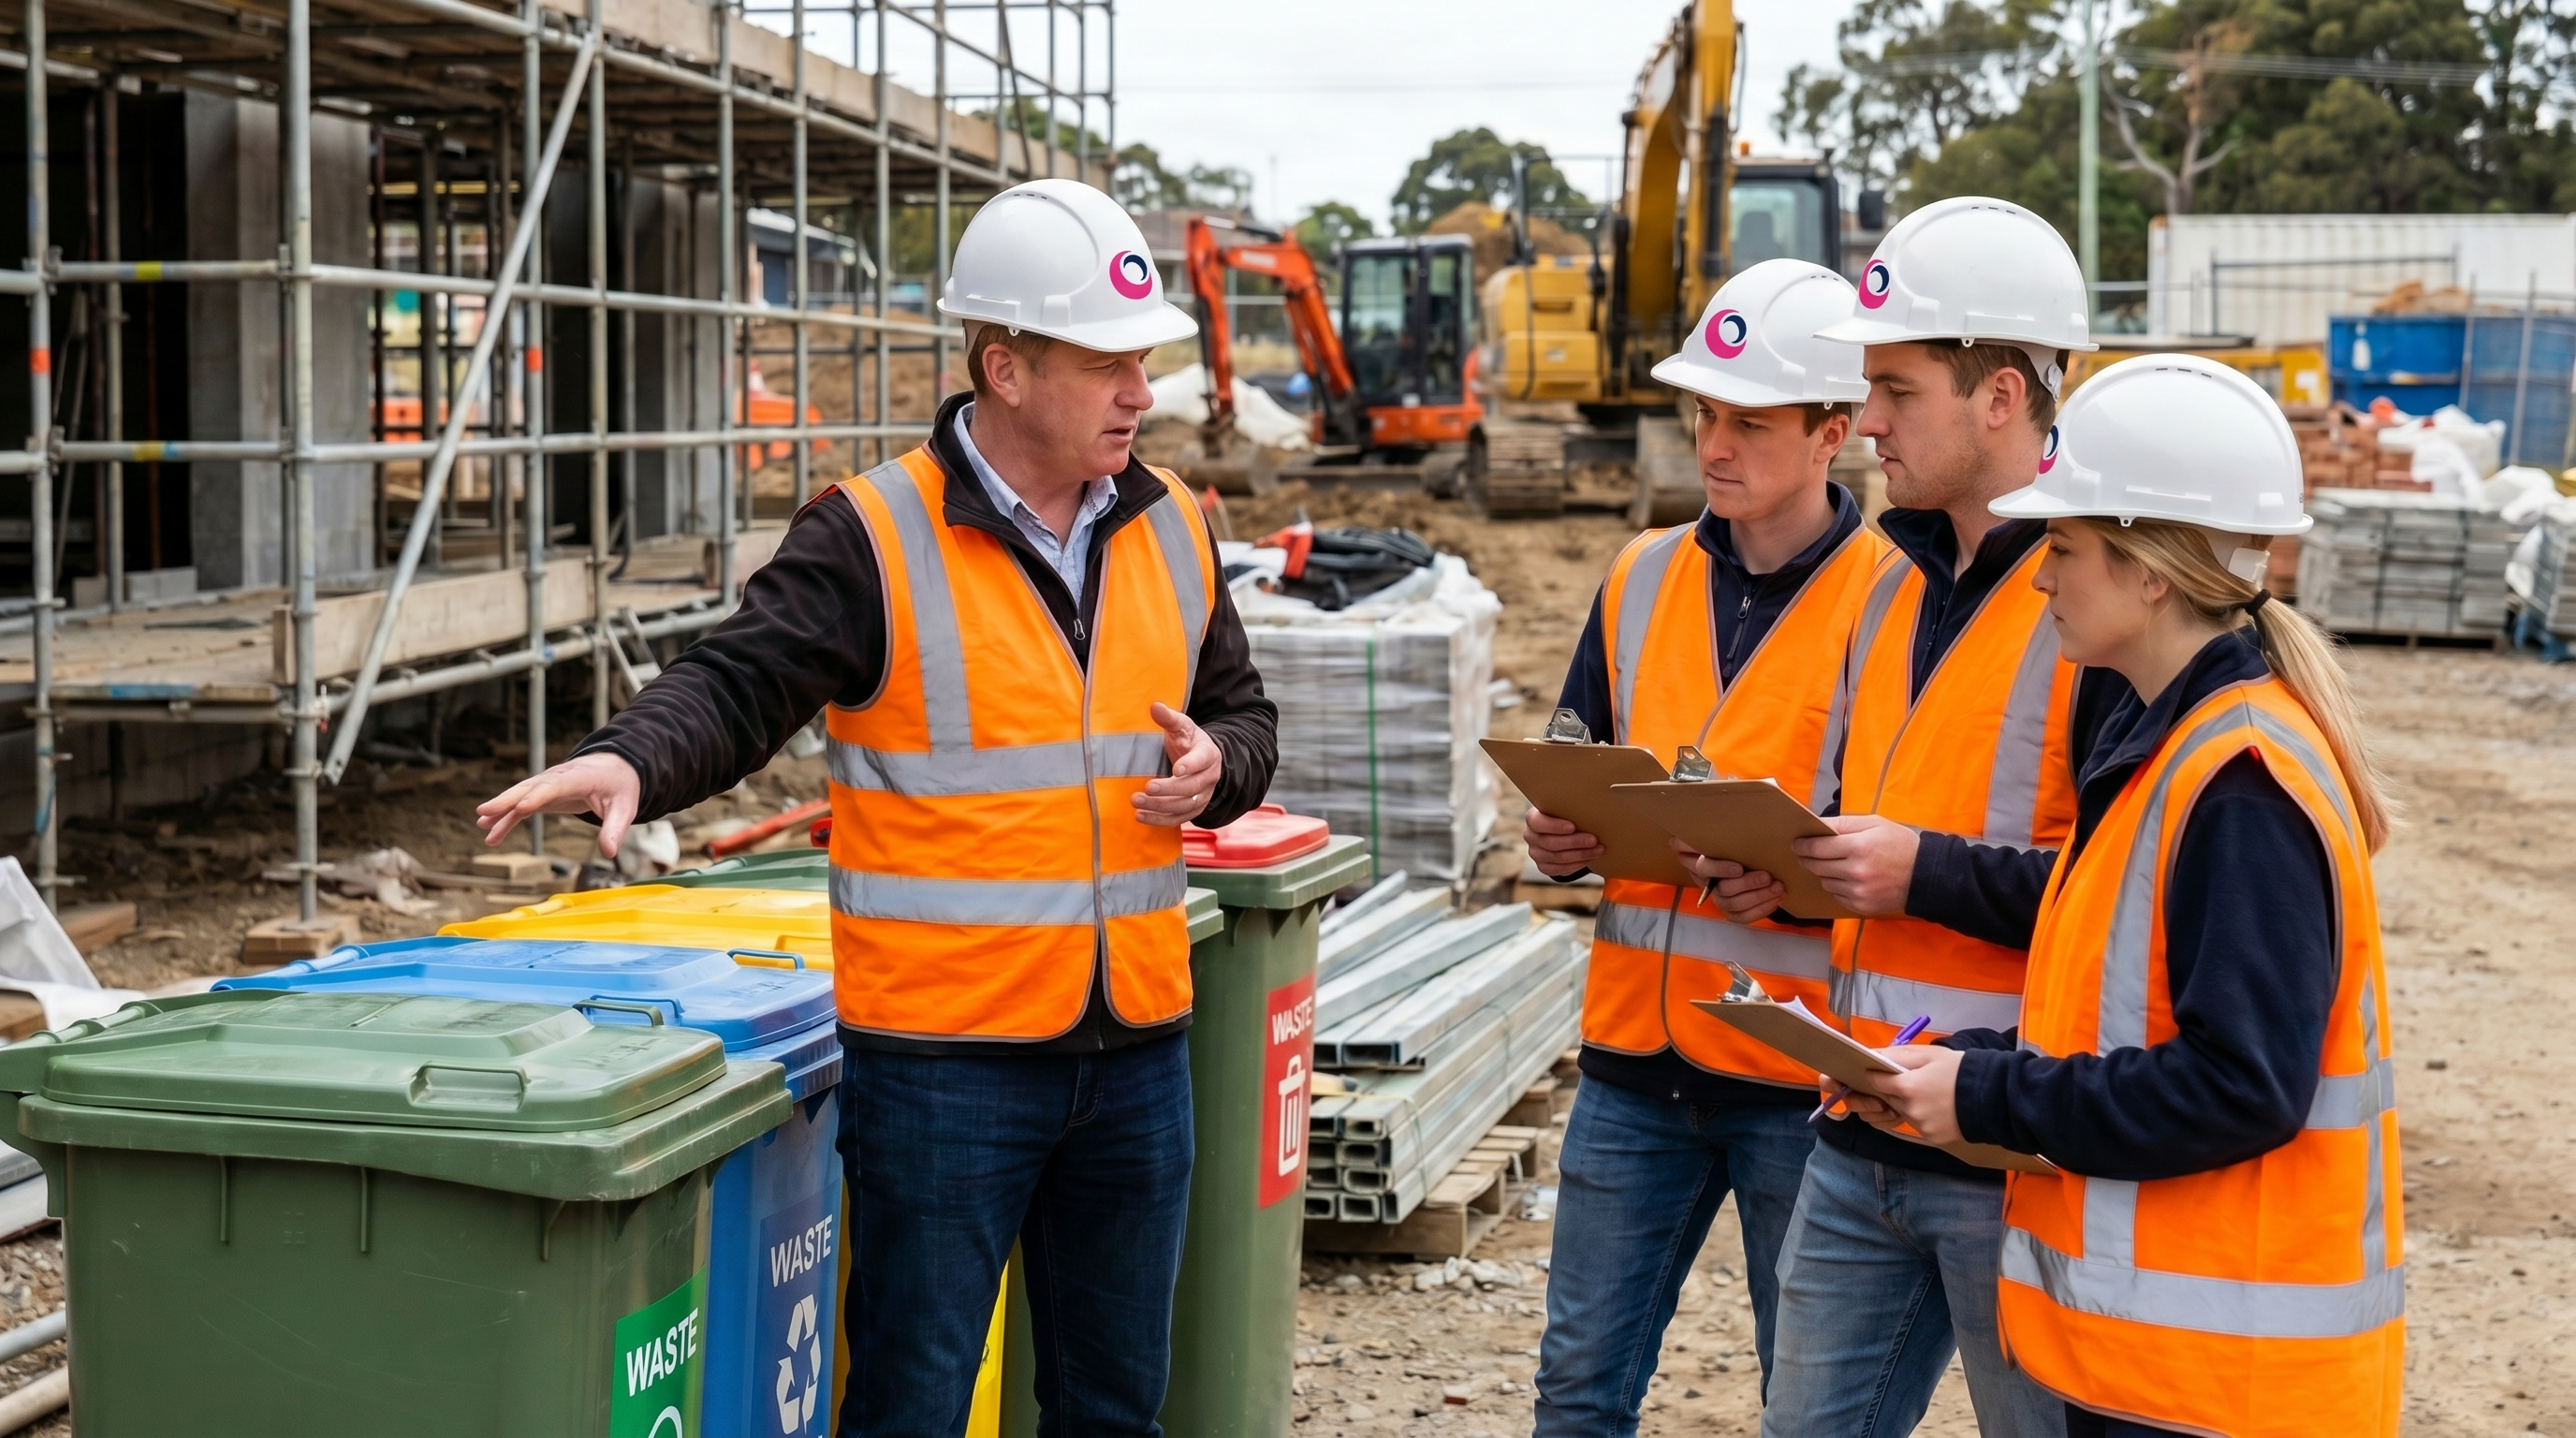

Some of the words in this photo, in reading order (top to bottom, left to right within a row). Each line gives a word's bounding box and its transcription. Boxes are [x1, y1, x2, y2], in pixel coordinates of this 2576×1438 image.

[1272, 996, 1312, 1045] WASTE
[771, 1214, 833, 1287] WASTE
[626, 1307, 698, 1397] WASTE
